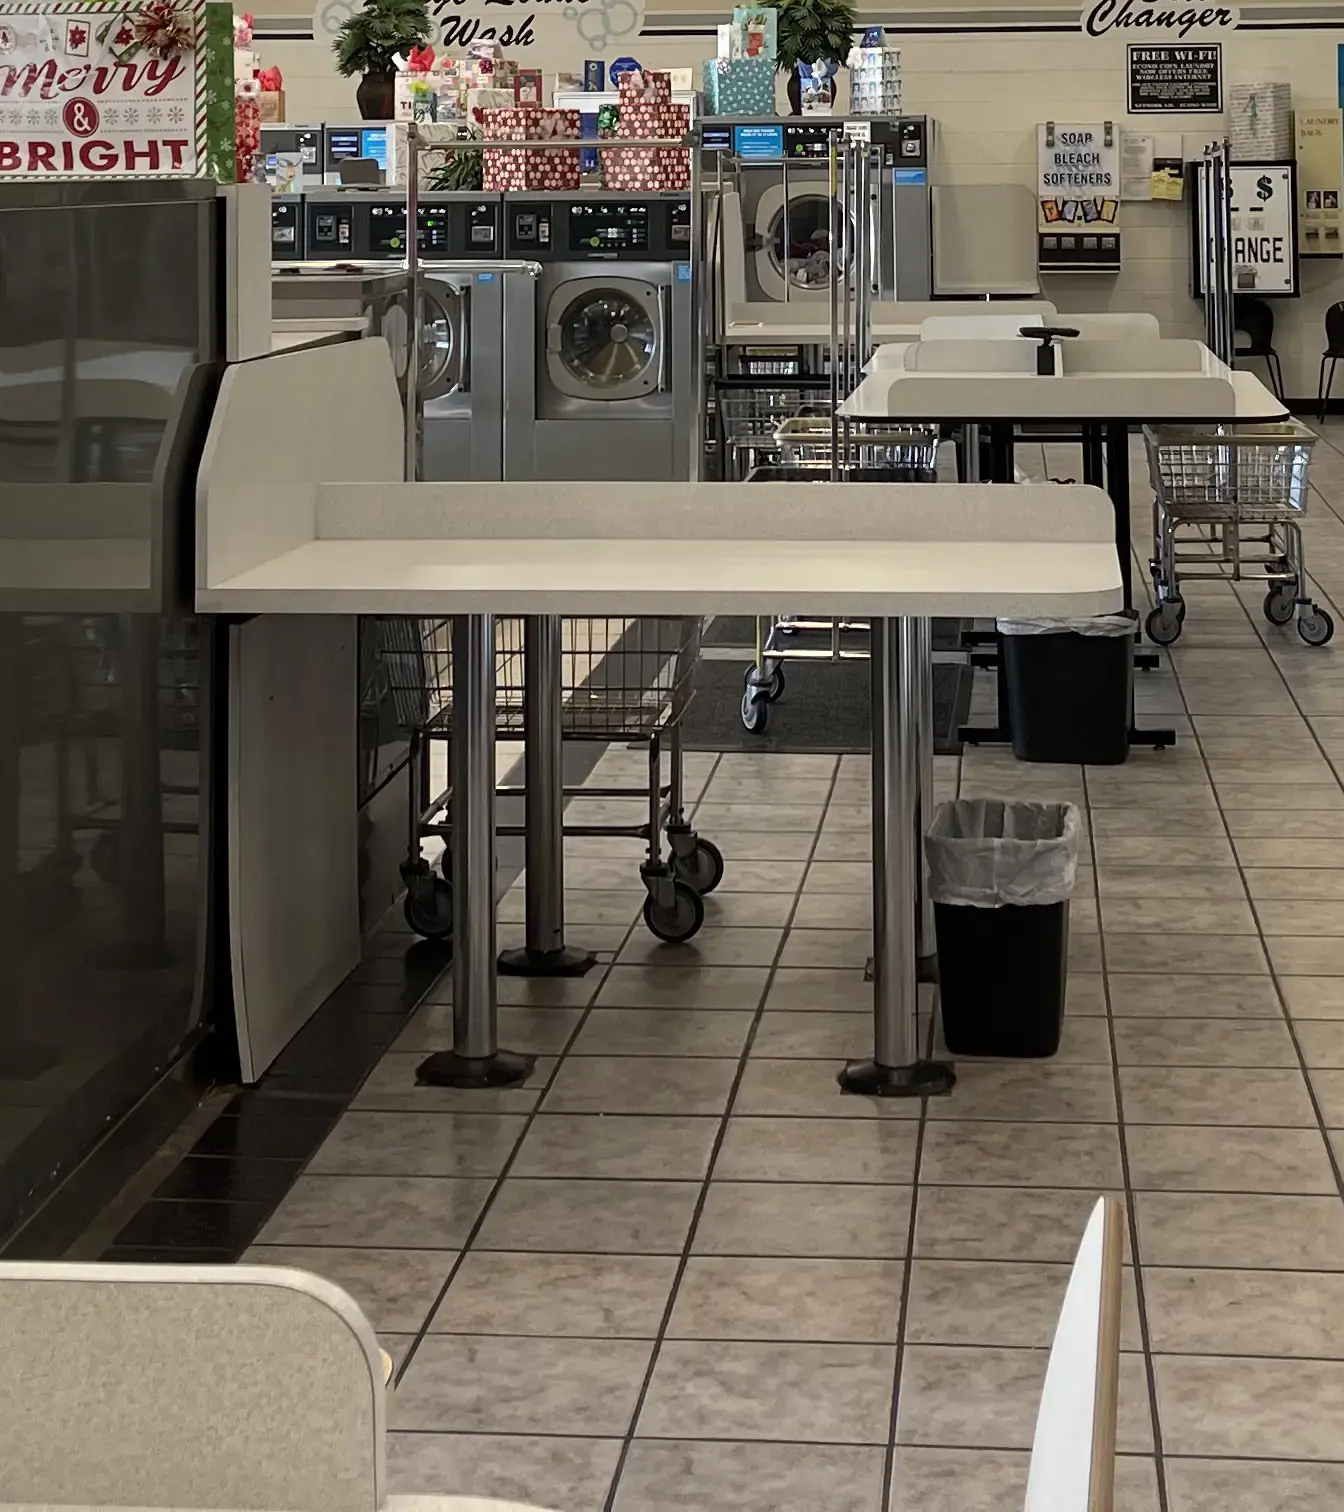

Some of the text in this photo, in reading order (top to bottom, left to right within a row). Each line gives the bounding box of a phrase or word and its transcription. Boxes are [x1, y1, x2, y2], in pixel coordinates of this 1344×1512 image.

[440, 14, 536, 48] Wash
[1132, 50, 1217, 61] FREE WI-FI!
[73, 101, 91, 131] &
[1300, 117, 1341, 126] LAUNDRY
[1061, 132, 1093, 144] SOAP
[1054, 153, 1100, 164] BLEACH
[1043, 172, 1112, 186] SOFTENERS
[1256, 174, 1273, 202] $
[1221, 237, 1285, 264] ANGE
